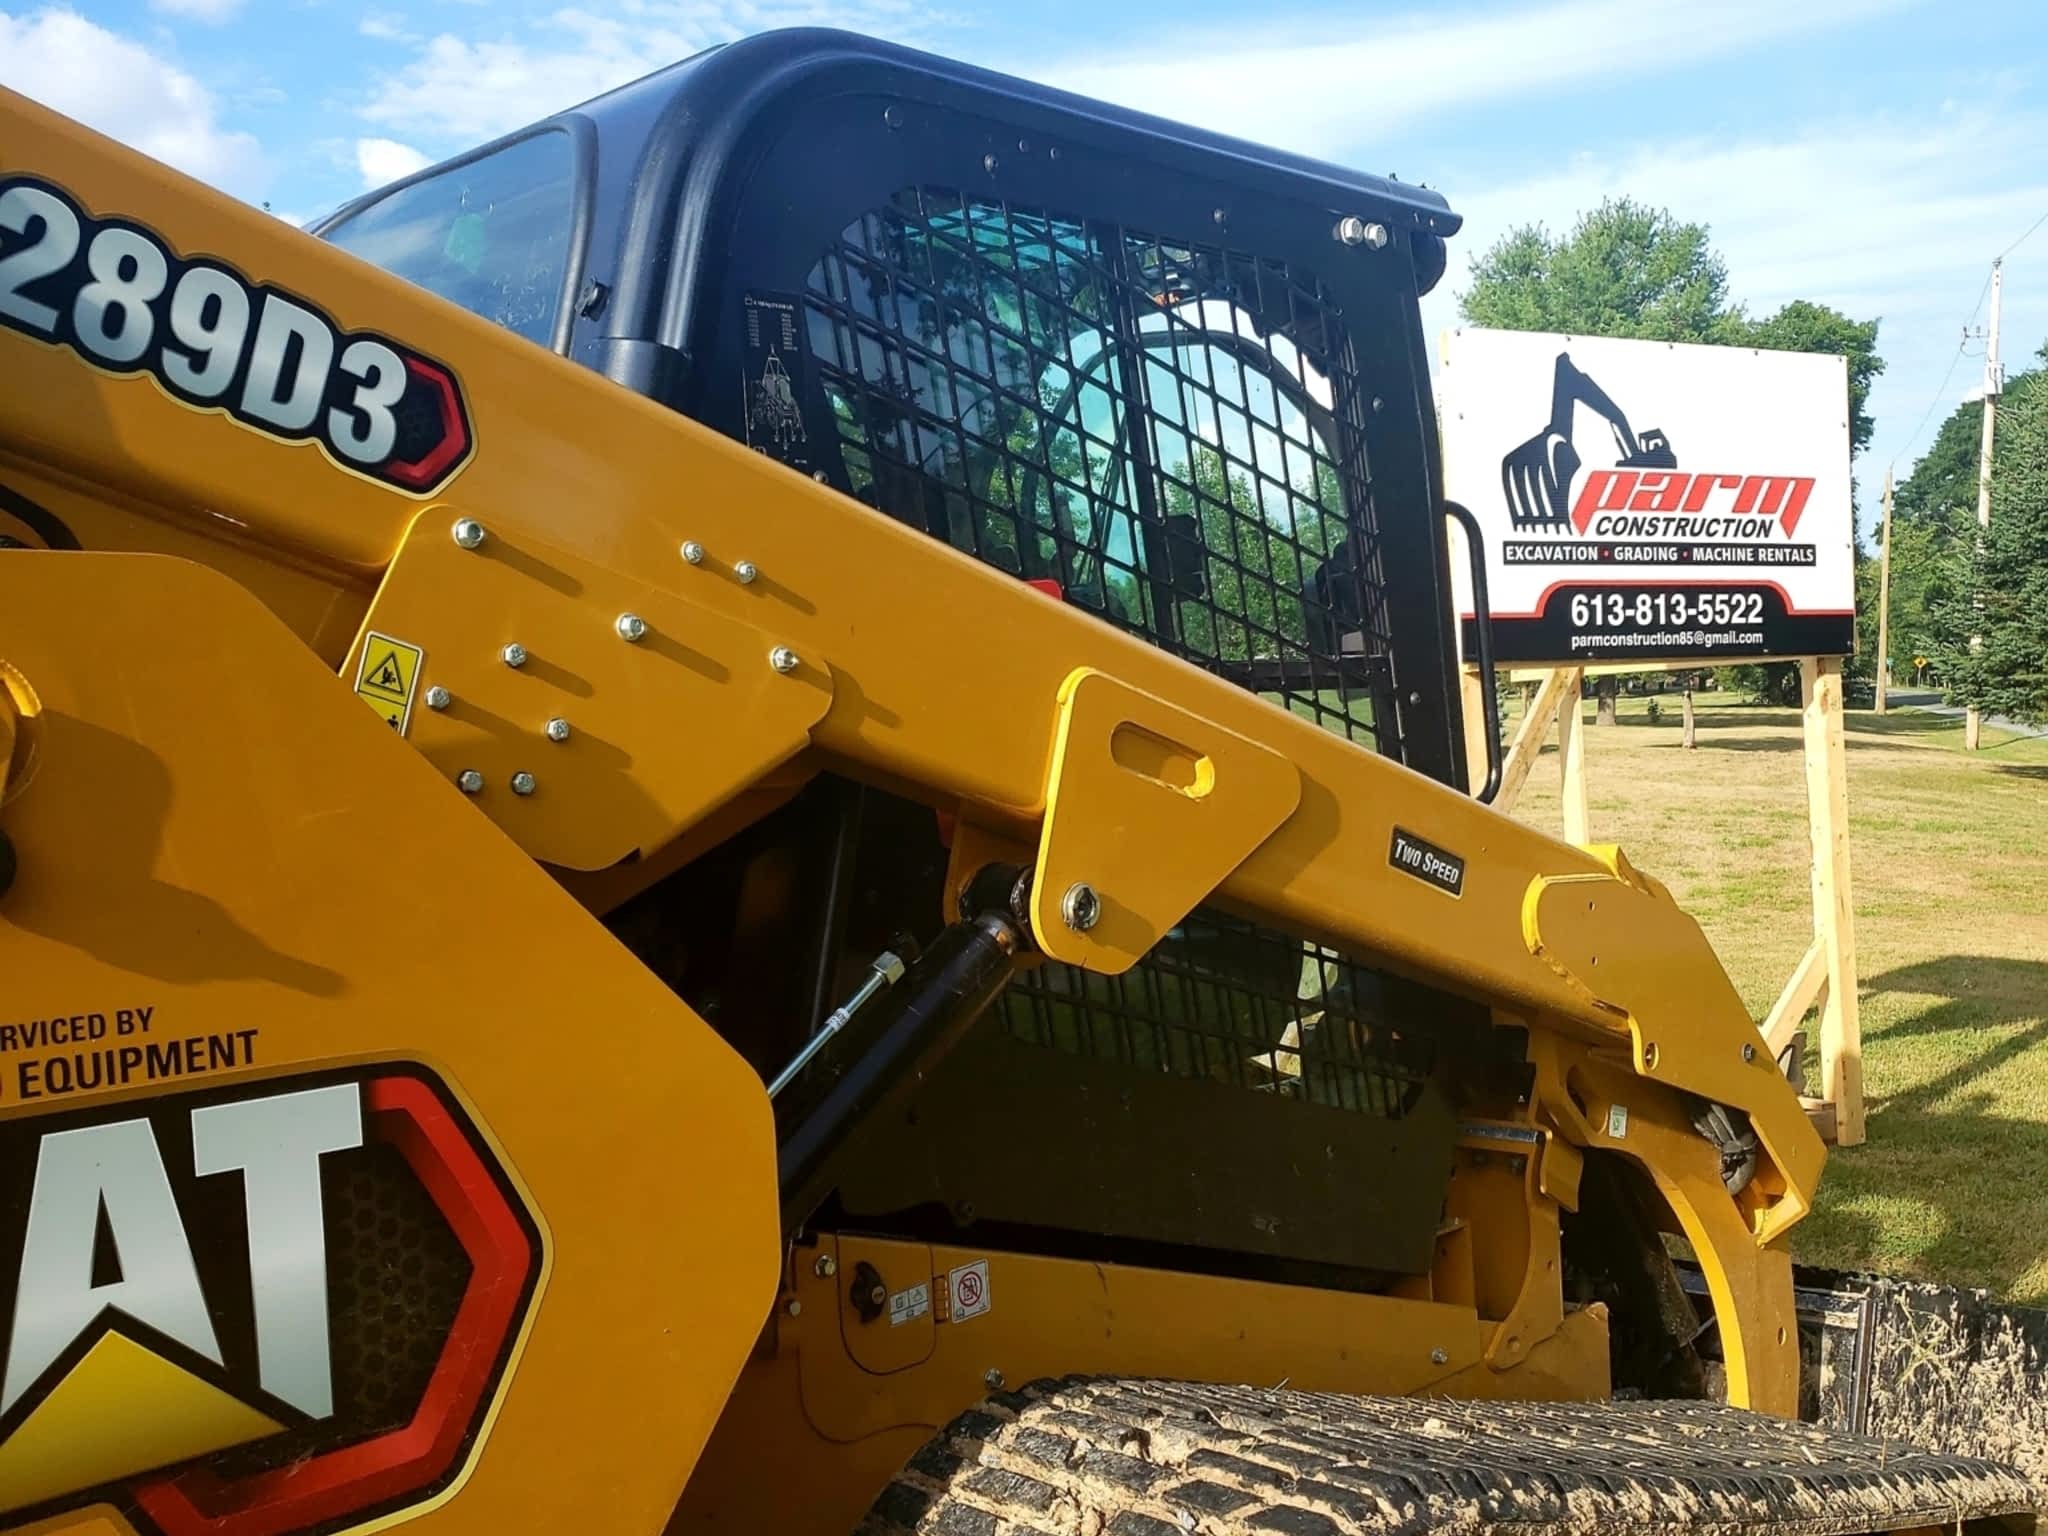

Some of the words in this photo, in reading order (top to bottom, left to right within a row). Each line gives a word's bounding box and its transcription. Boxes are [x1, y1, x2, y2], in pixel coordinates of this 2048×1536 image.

[0, 187, 407, 463] 289D3
[1594, 516, 1775, 539] CONSTRUCTION
[1506, 545, 1599, 561] EXCAVATION
[1613, 546, 1679, 562] GRADING
[1692, 547, 1755, 562] MACHINE
[1758, 548, 1815, 563] RENTALS
[1571, 593, 1764, 626] 613-813-5522
[1571, 631, 1764, 650] parmconstruction85@gmail.com
[116, 1006, 154, 1036] BY
[18, 1029, 259, 1099] EQUIPMENT
